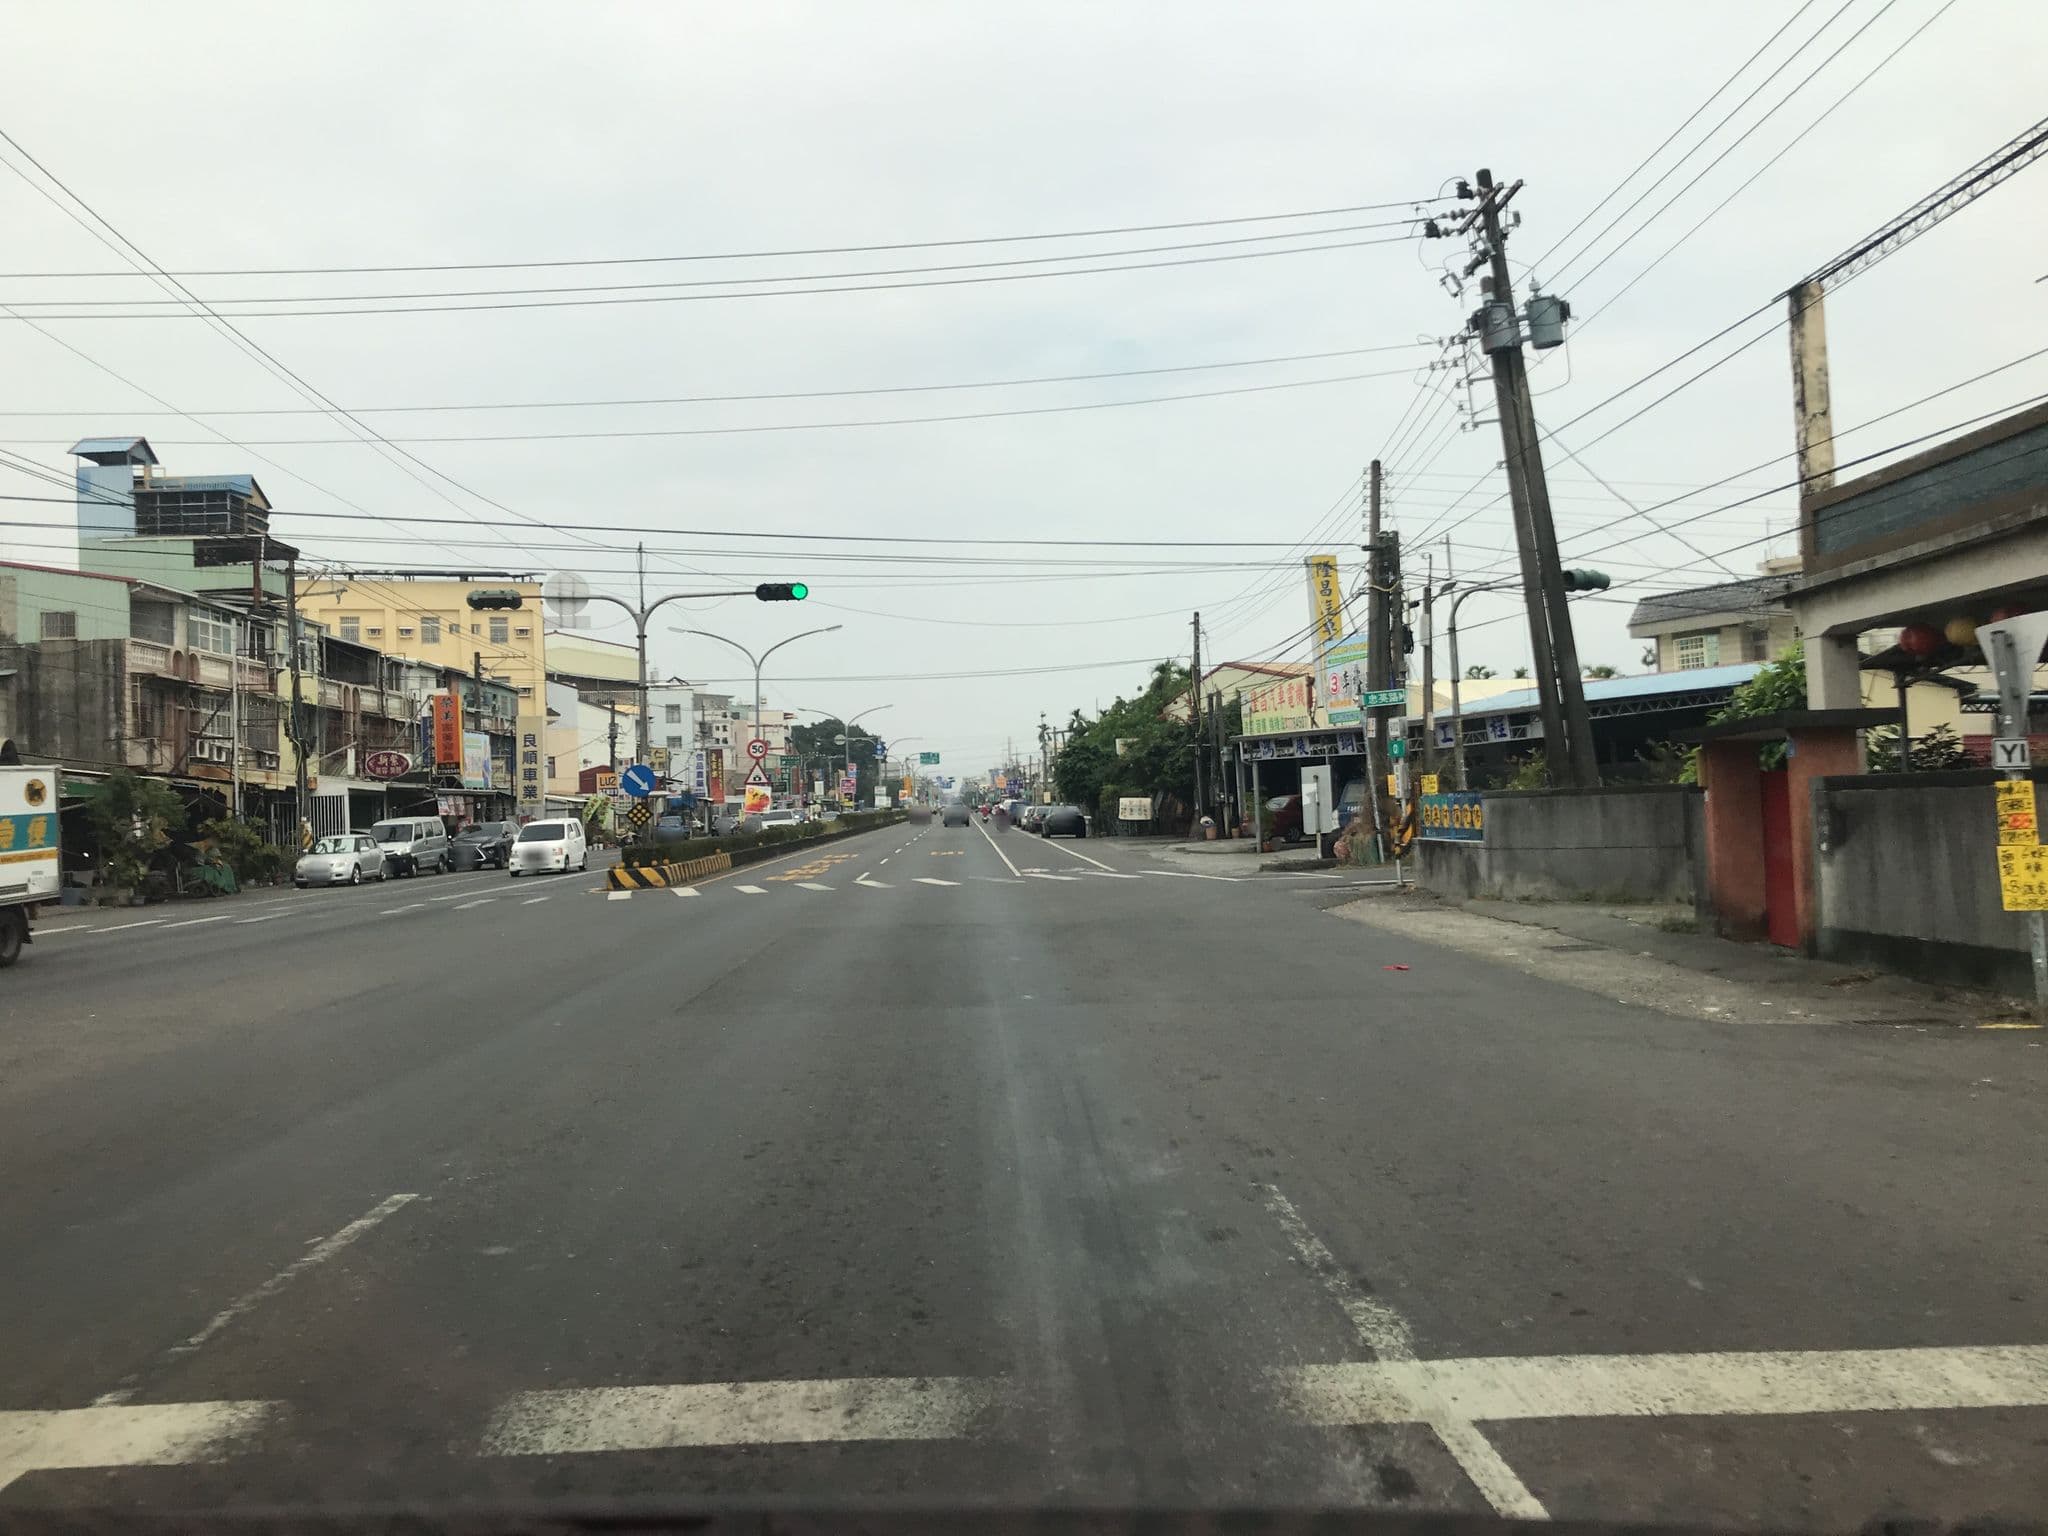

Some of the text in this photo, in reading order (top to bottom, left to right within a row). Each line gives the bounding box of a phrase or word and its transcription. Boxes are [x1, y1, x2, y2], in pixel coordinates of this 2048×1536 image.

[522, 733, 538, 799] 良順車業
[751, 745, 764, 754] 50
